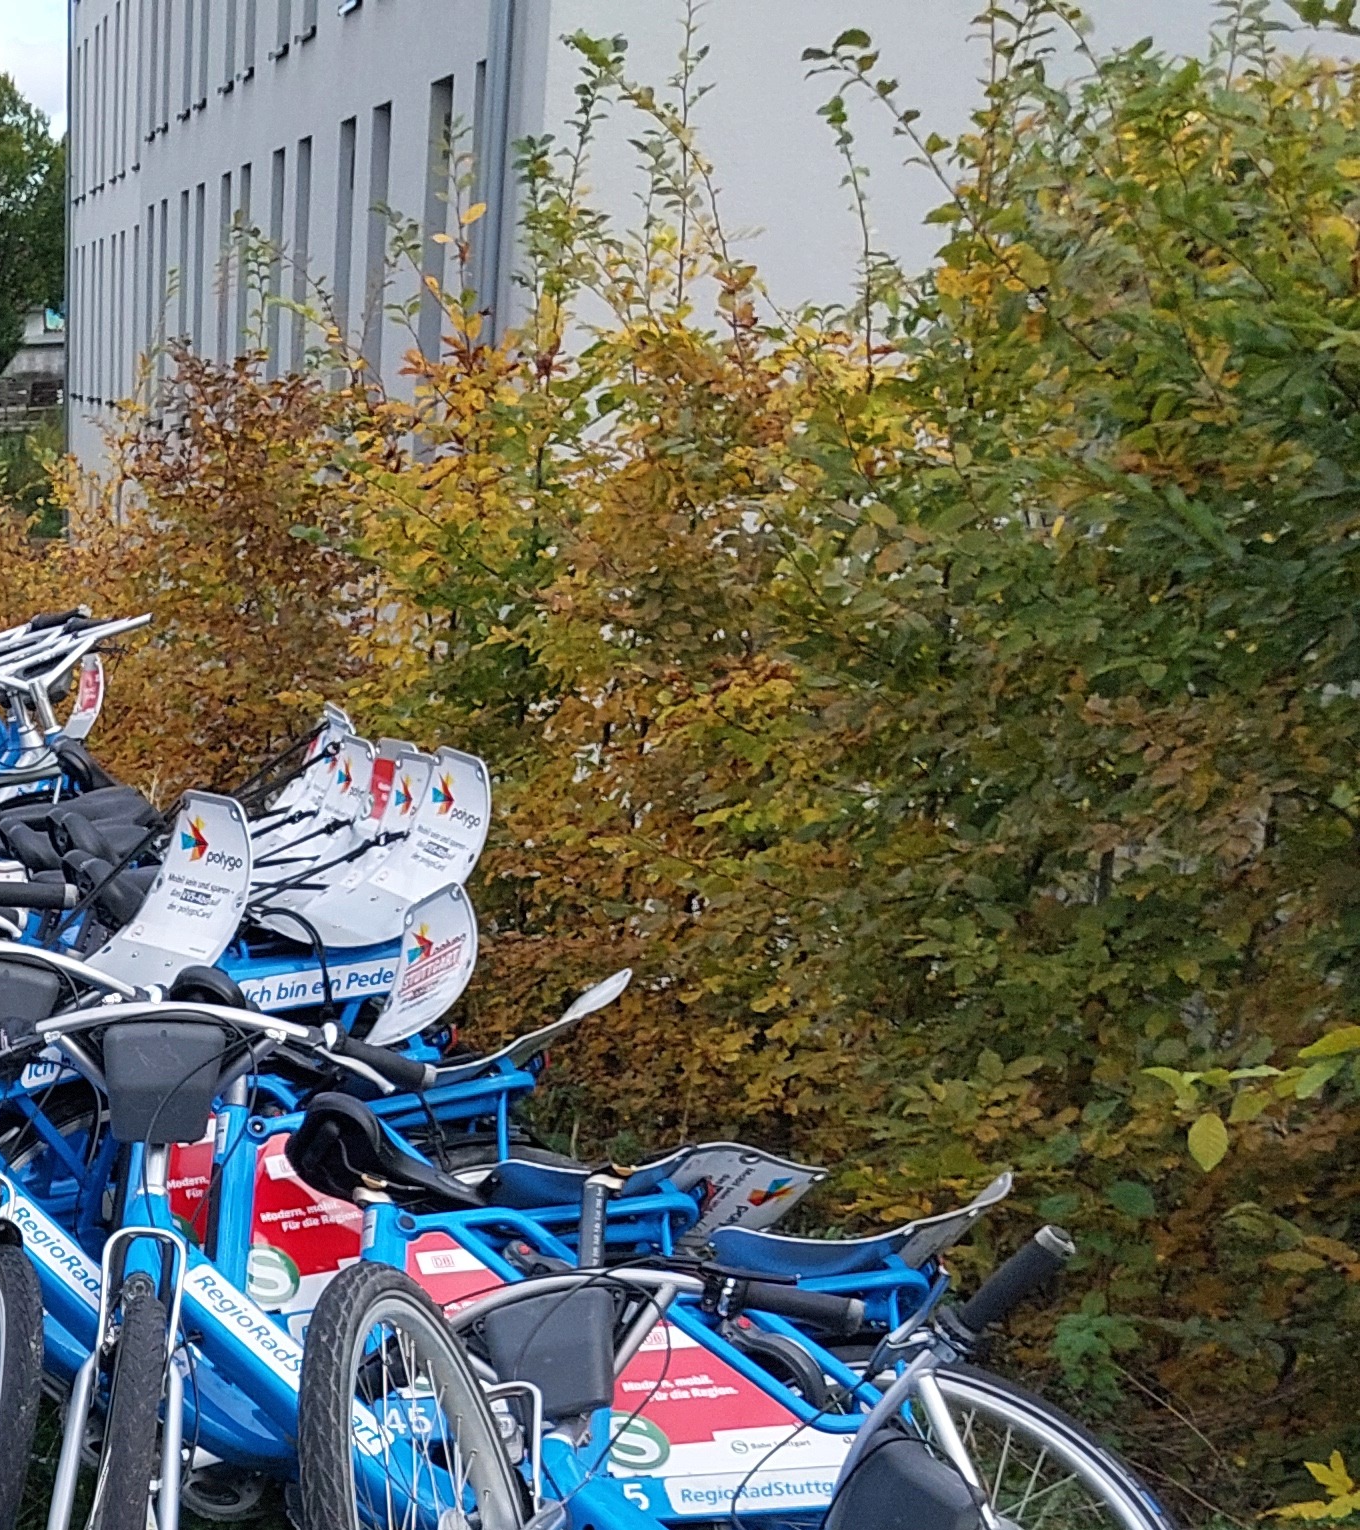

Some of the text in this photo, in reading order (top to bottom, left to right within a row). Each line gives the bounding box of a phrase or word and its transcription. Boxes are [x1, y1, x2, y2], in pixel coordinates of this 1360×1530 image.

[449, 807, 481, 830] polygo
[204, 850, 243, 872] polygo
[276, 981, 307, 1000] bin
[311, 976, 341, 995] en
[346, 967, 395, 990] Pede
[260, 1206, 306, 1223] Modern,
[281, 1210, 362, 1232] Für die Region.
[433, 1255, 453, 1267] DB
[675, 1374, 714, 1387] mobil.
[669, 1389, 690, 1401] die
[691, 1386, 739, 1398] Region.
[680, 1478, 836, 1507] RegioRadStuttg
